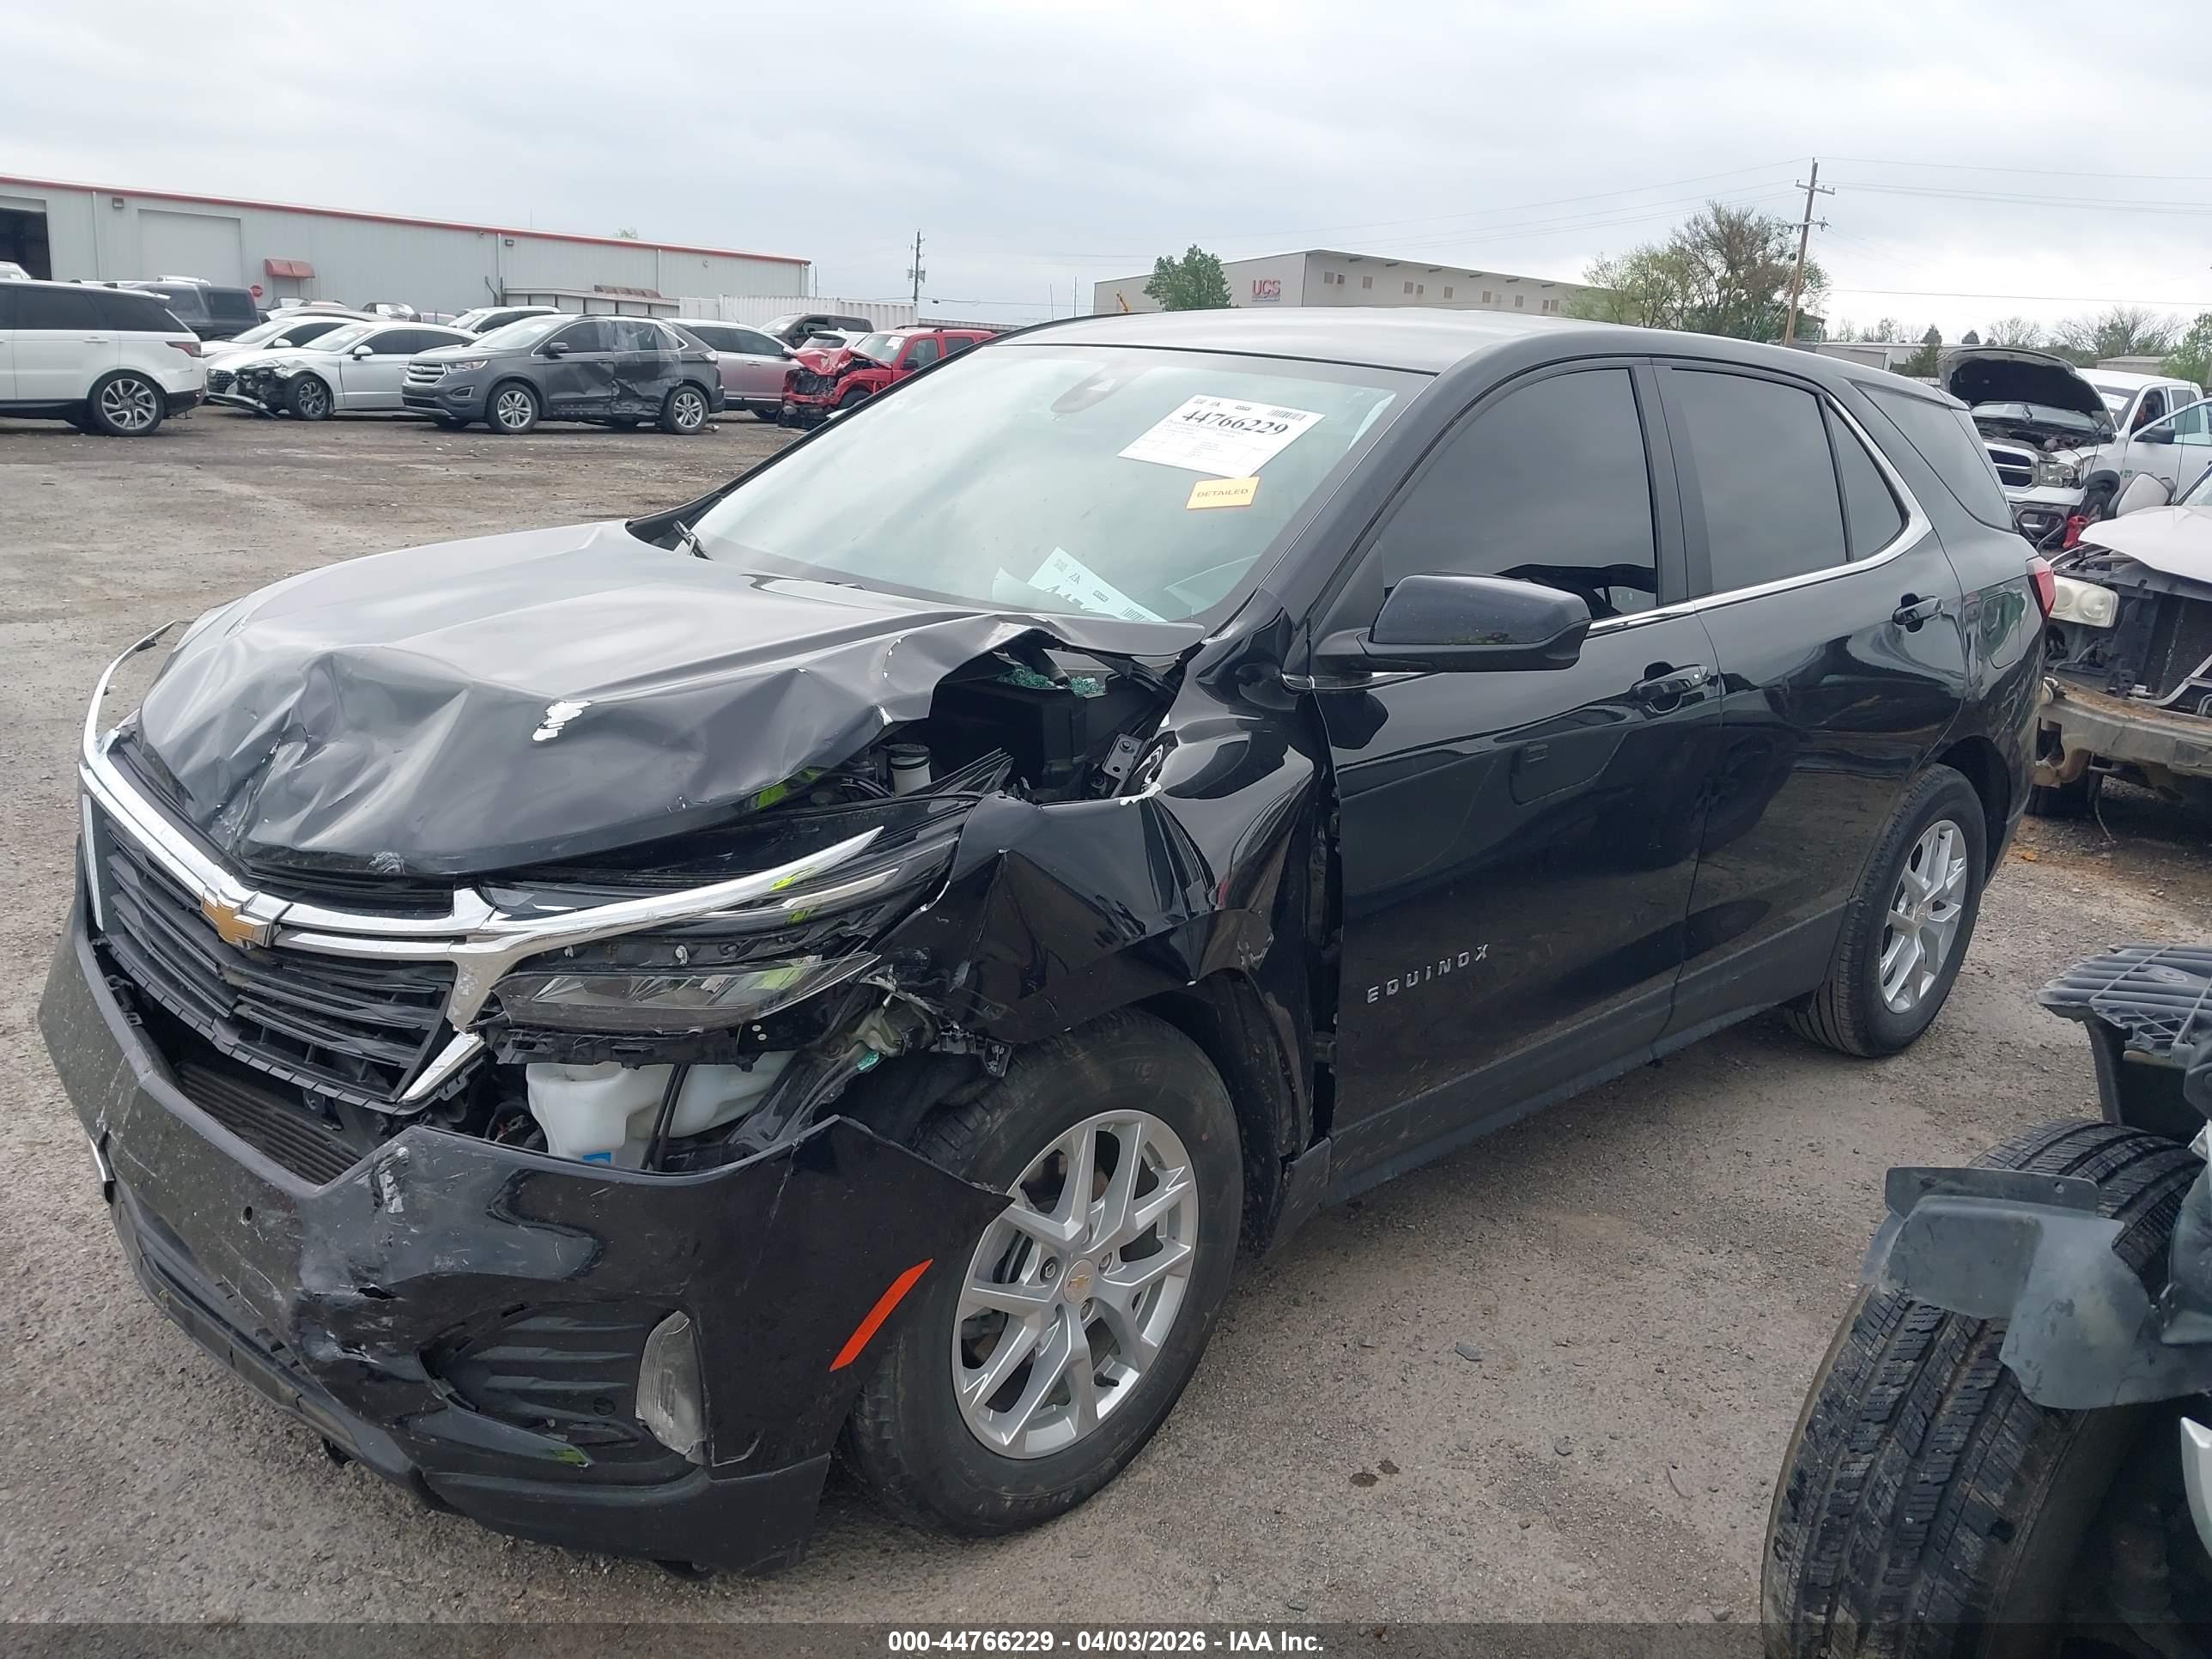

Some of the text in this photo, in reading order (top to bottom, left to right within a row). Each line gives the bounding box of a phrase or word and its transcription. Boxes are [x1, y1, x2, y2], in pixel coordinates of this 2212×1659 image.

[1182, 409, 1289, 435] 44766229
[1196, 487, 1249, 498] DETAILED
[1366, 944, 1489, 1004] EQUINOX
